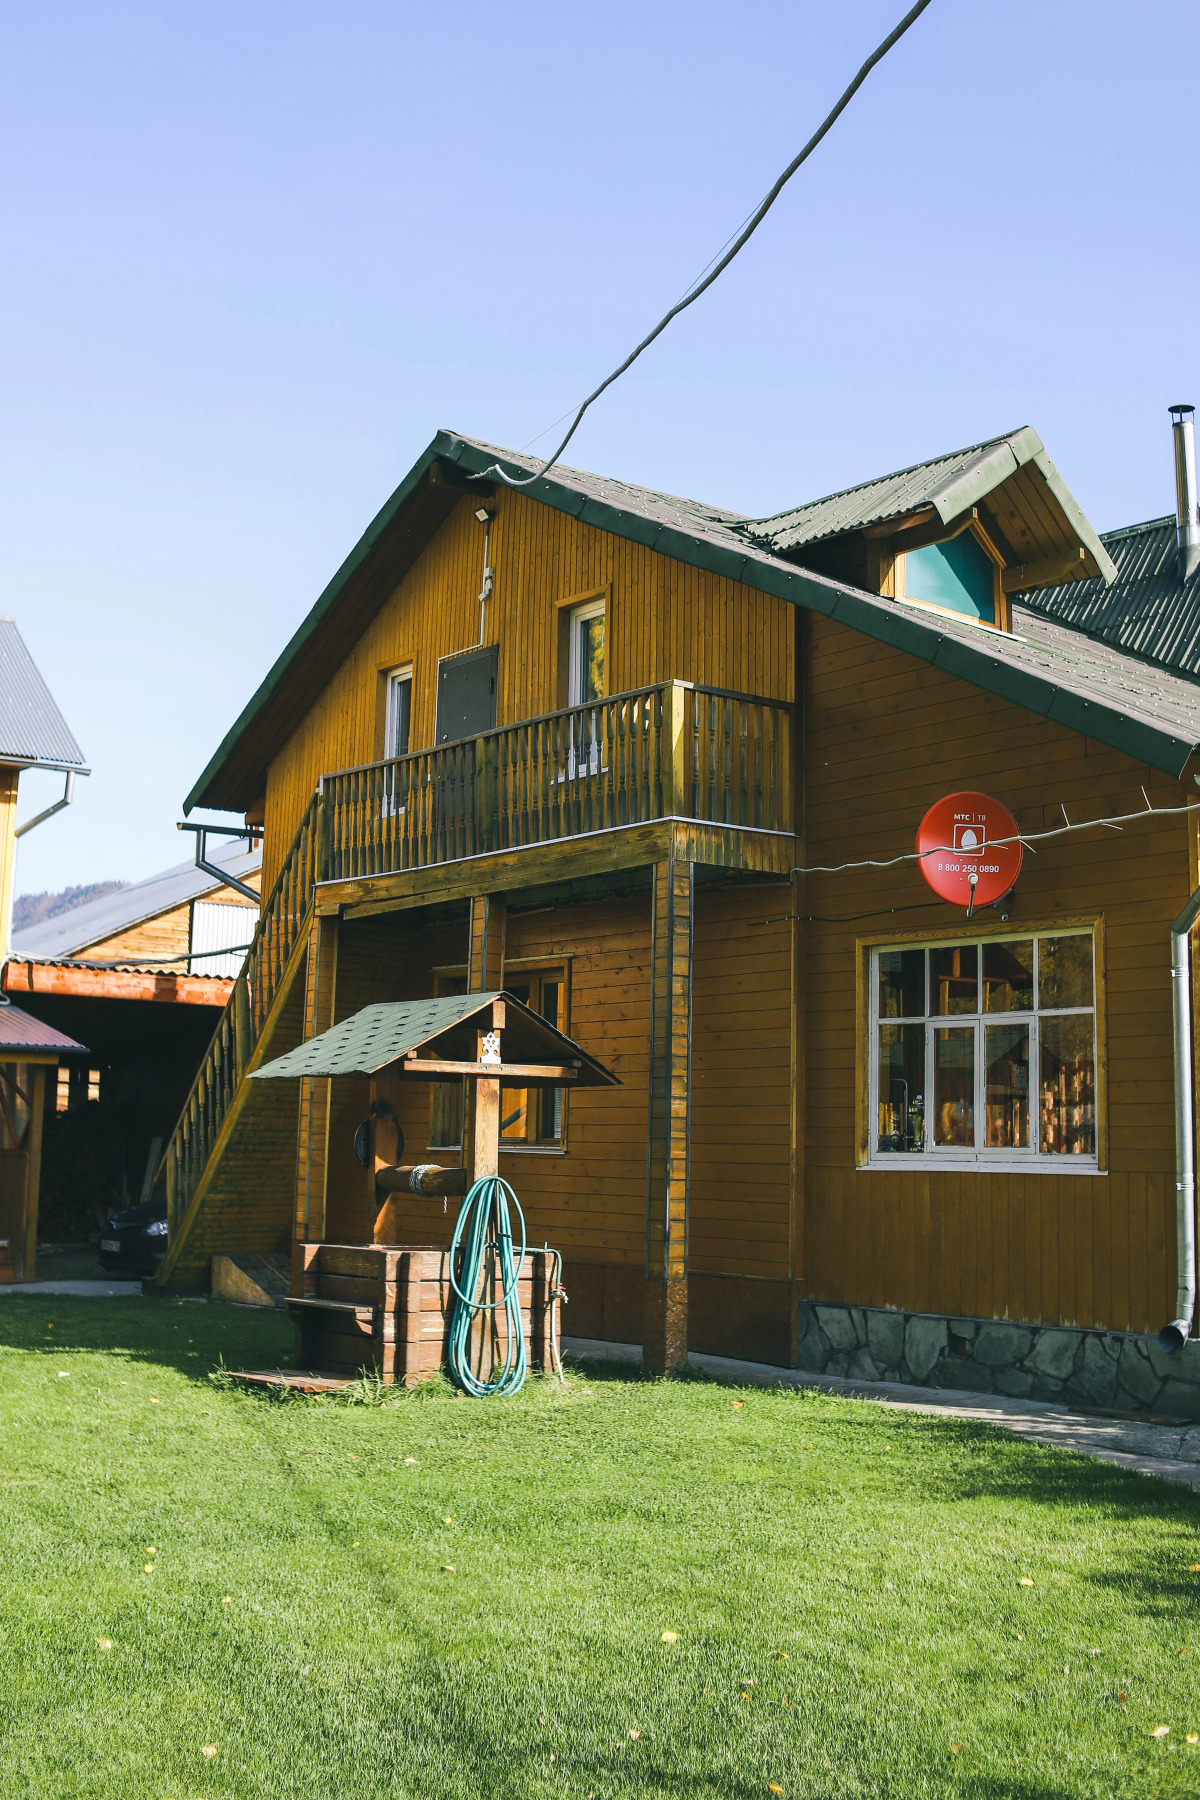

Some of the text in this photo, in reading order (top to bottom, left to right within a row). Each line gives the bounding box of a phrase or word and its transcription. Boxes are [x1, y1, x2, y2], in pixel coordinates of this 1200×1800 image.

[953, 813, 970, 821] МТС
[937, 863, 1000, 873] 8 800 250 0890
